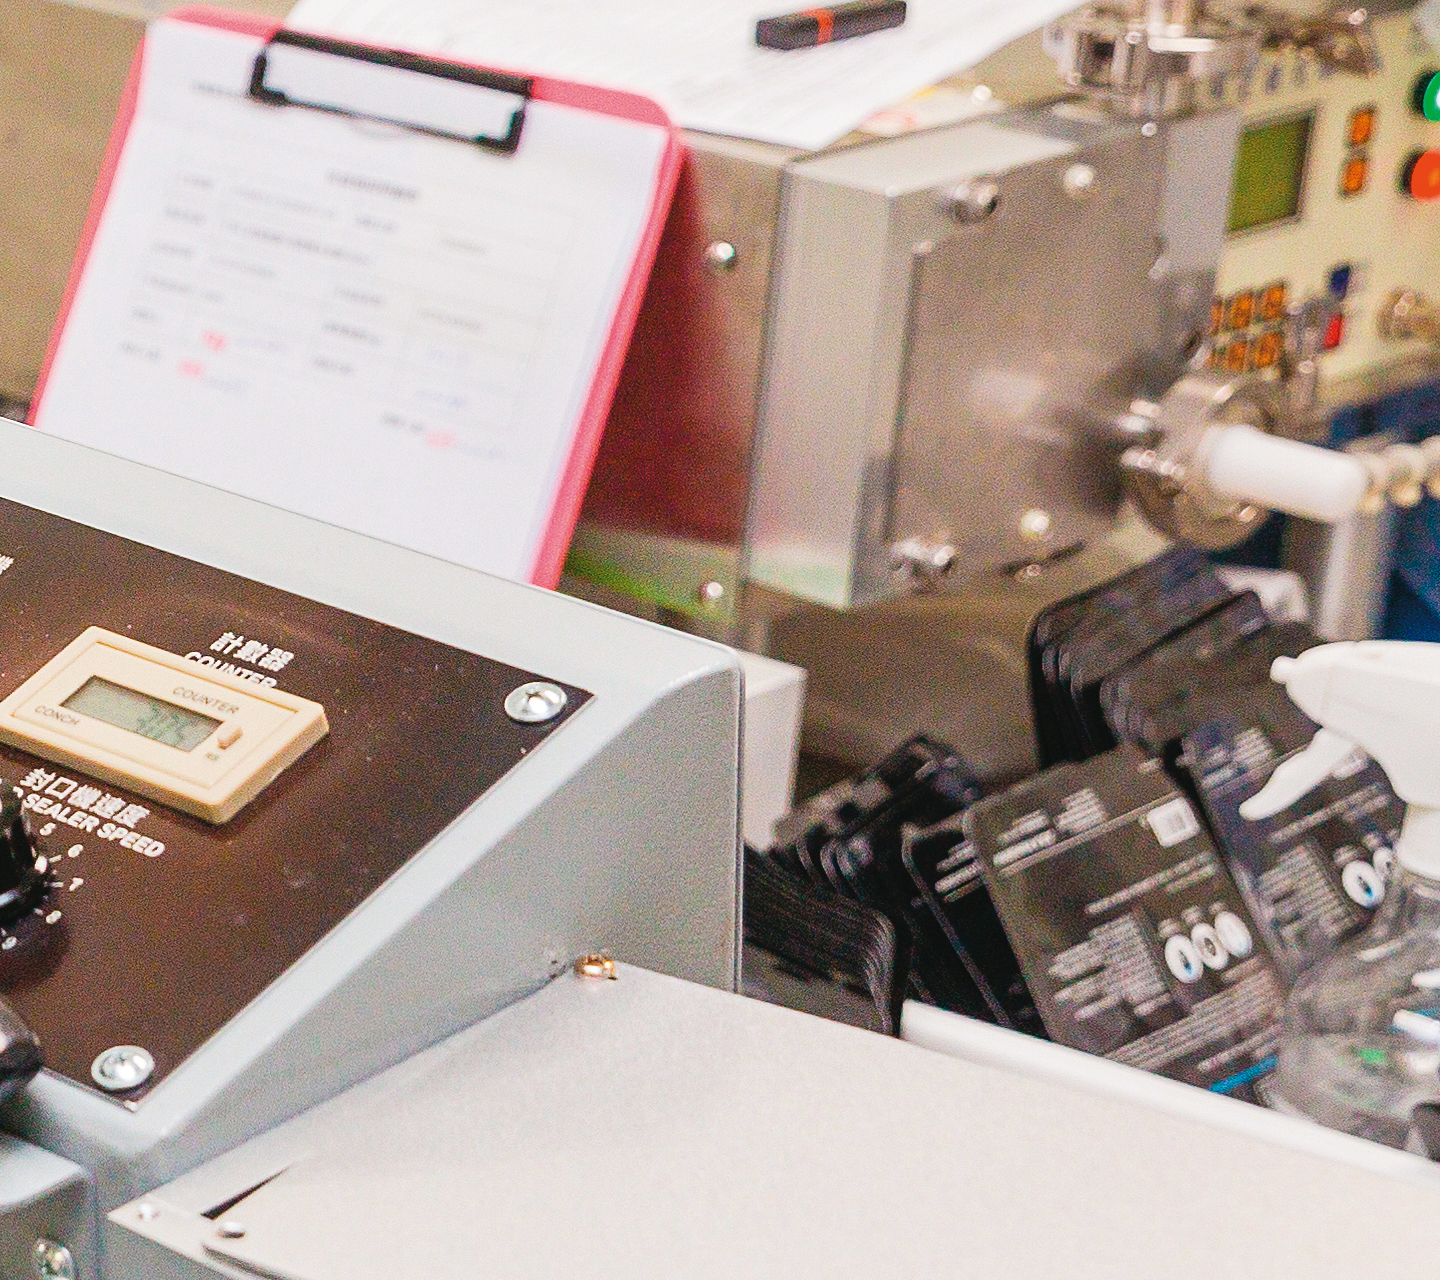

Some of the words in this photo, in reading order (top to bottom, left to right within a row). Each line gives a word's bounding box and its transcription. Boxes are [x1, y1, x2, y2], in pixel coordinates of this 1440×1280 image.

[183, 650, 278, 689] COUNTER
[209, 631, 295, 672] 計數器
[34, 704, 80, 726] CONCH
[171, 685, 240, 715] COUNTER
[22, 793, 100, 833] SEALER
[96, 821, 166, 858] SPEED
